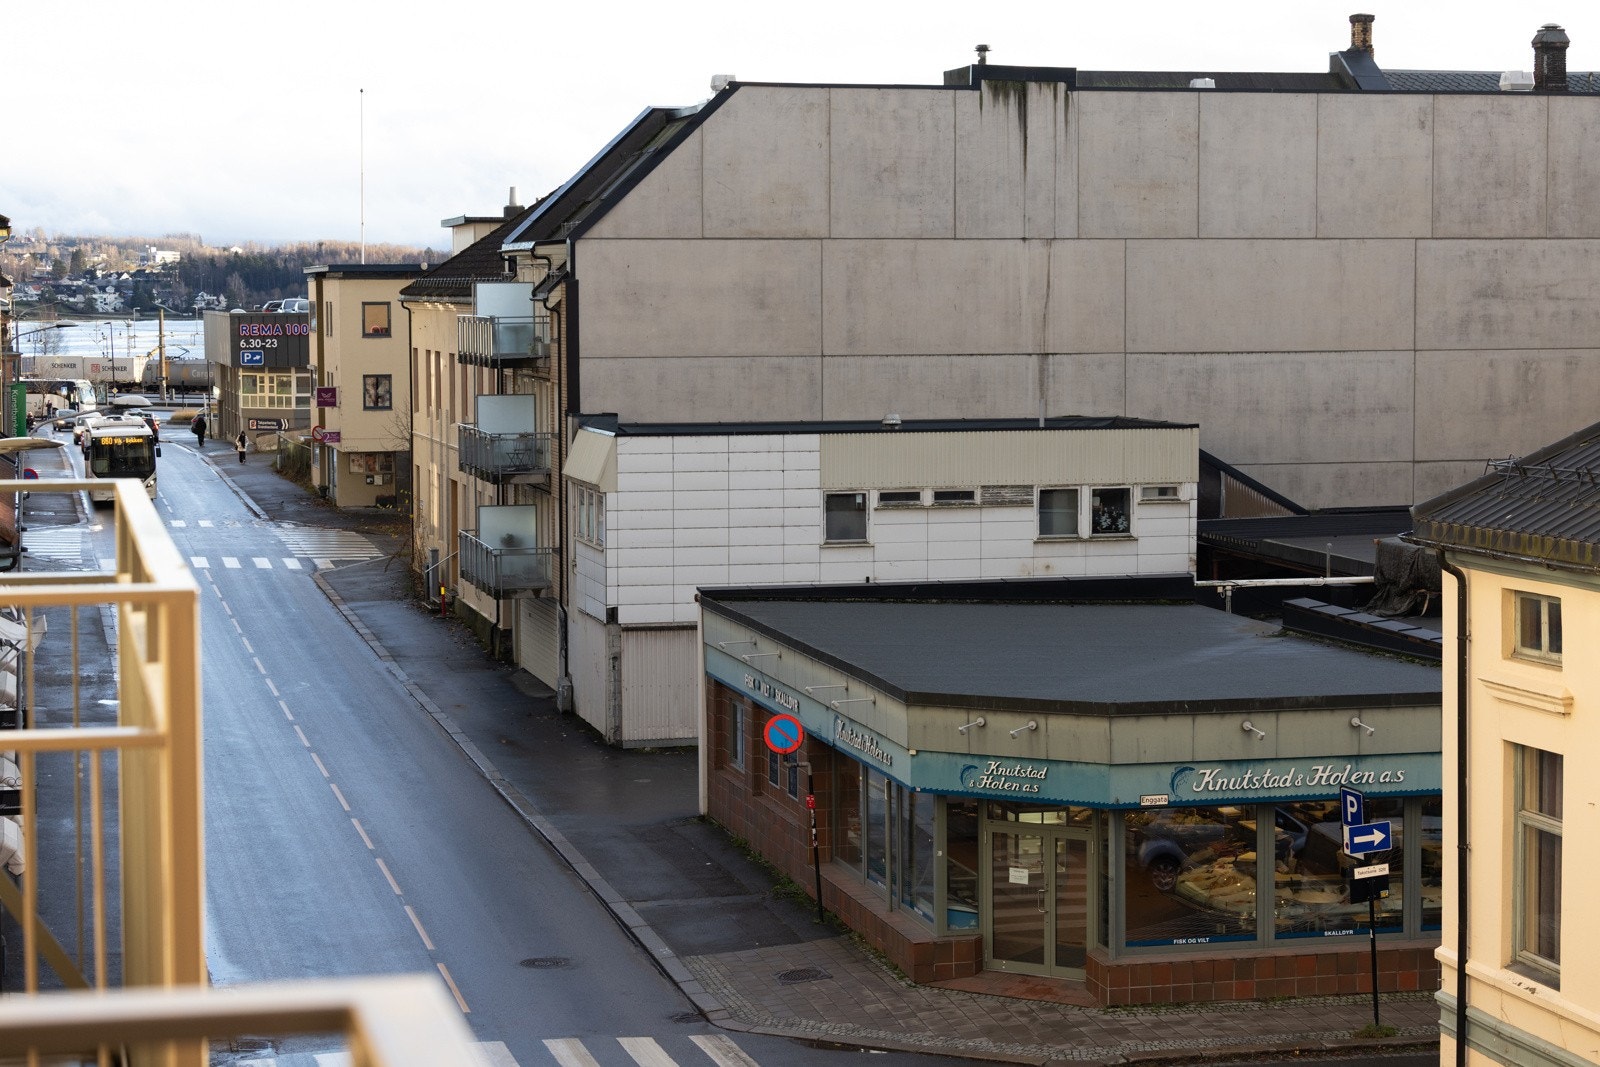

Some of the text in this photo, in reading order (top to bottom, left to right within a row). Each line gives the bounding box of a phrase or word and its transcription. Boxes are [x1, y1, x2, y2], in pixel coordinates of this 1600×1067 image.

[240, 324, 282, 336] REMA
[240, 339, 278, 348] 6.30-23
[244, 353, 252, 362] P
[192, 370, 214, 379] Cargo
[324, 432, 330, 442] 2
[744, 672, 755, 690] FISK
[776, 689, 798, 712] SKALLDYR
[836, 719, 862, 750] Knutstad
[864, 734, 882, 762] Holen
[984, 761, 1049, 780] Knutstad
[970, 779, 974, 788] &
[976, 775, 1020, 792] Holen
[1192, 768, 1295, 792] Knutstad
[1296, 773, 1302, 786] &
[1306, 764, 1374, 787] Holen
[1142, 796, 1168, 806] Enggata
[1346, 794, 1358, 822] P
